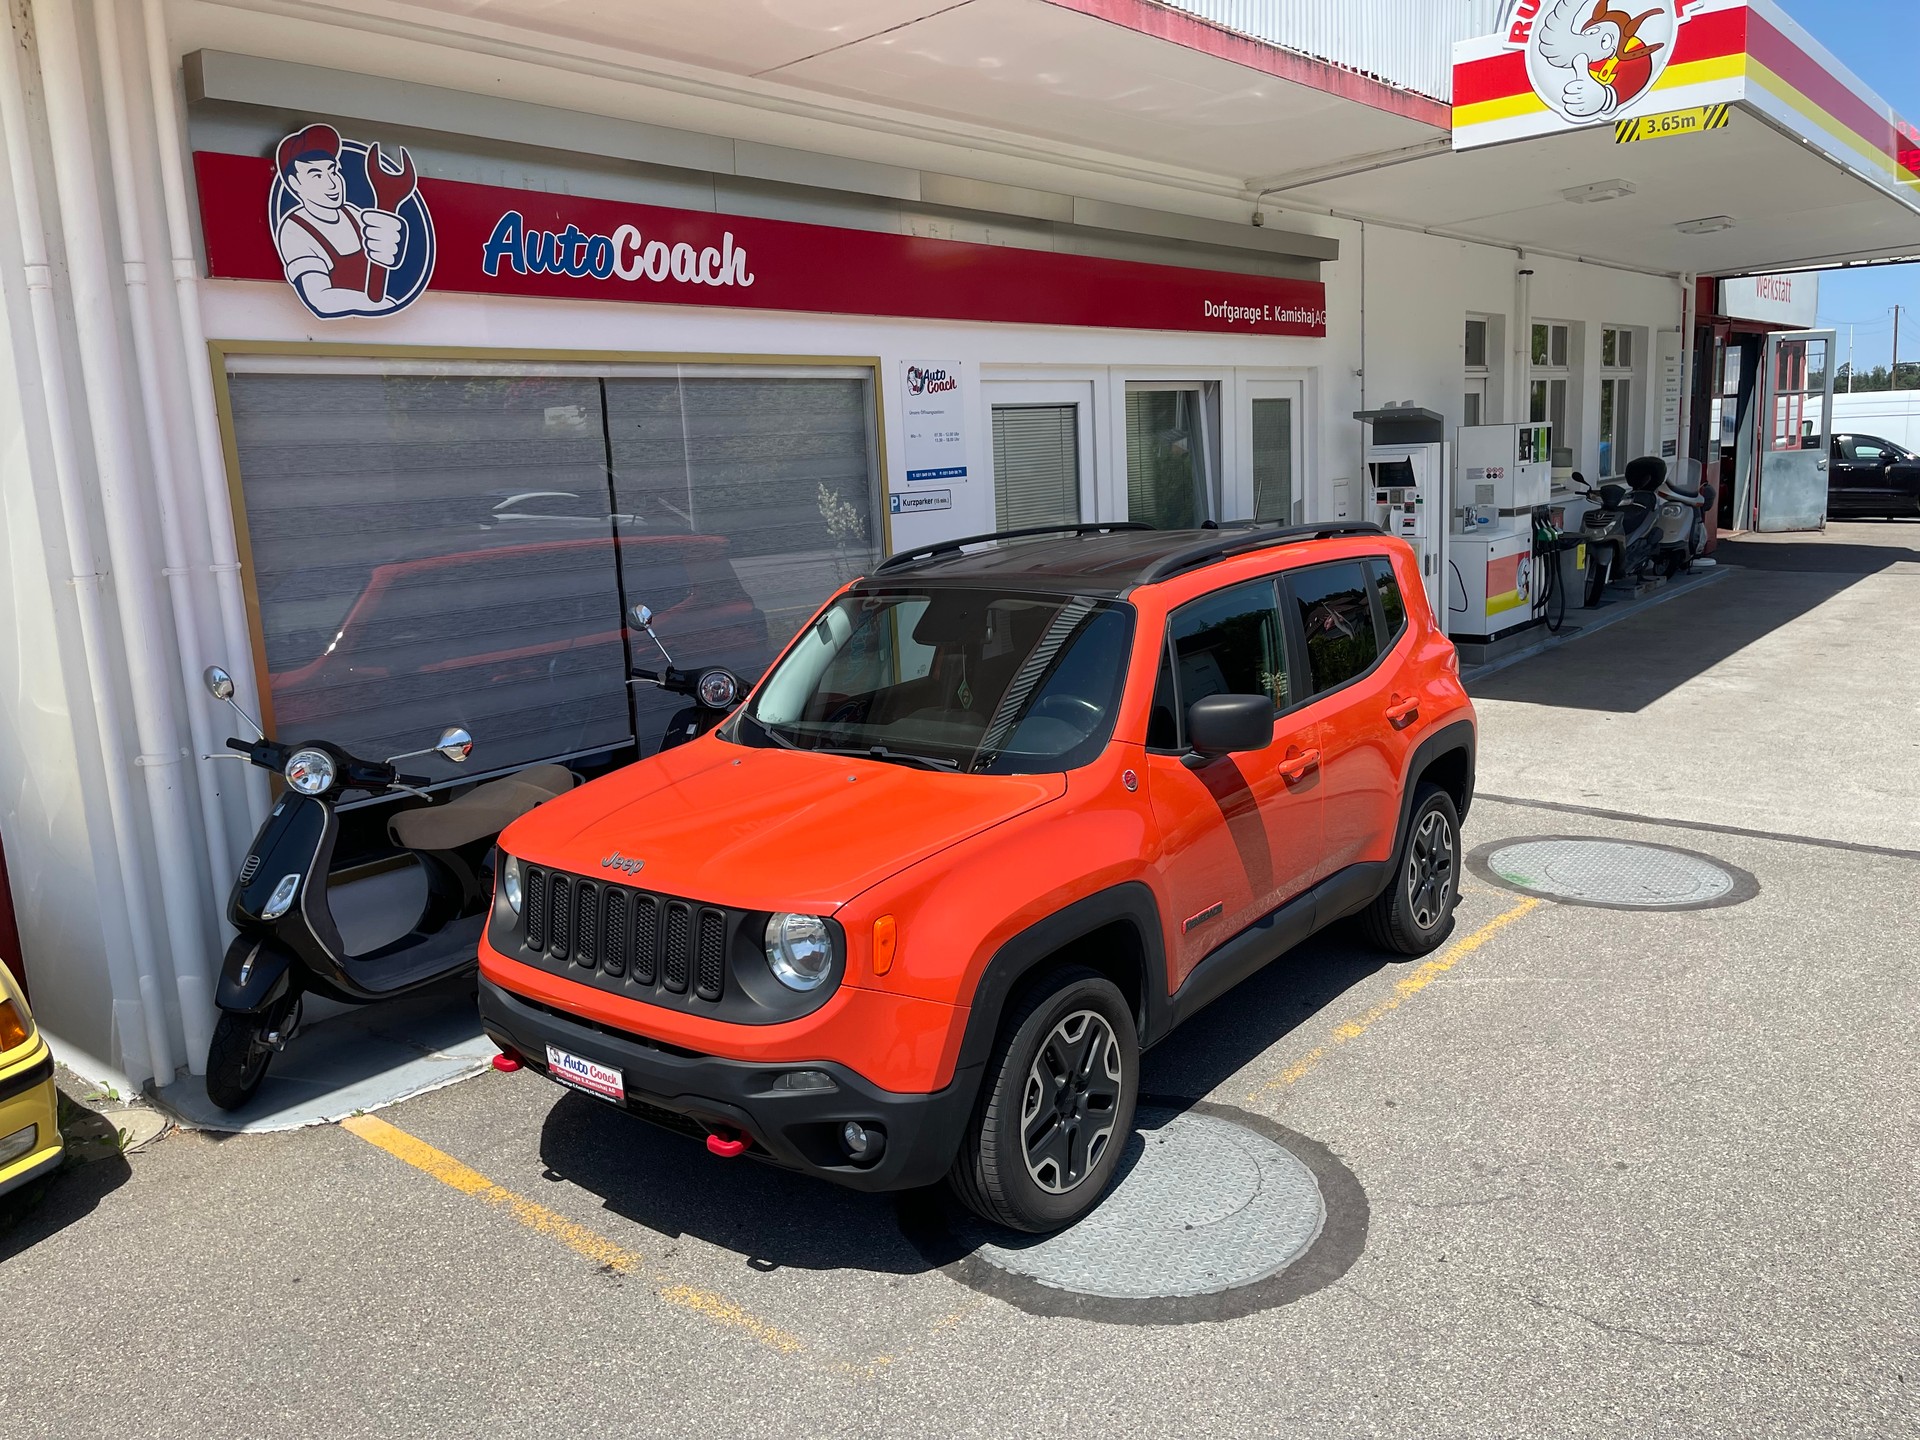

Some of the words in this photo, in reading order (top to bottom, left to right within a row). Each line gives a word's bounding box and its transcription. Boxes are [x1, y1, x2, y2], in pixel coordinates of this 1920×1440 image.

[1646, 113, 1696, 134] 3.65m
[1756, 275, 1792, 303] Werkstatt
[1204, 299, 1262, 324] Dorfgarage
[1263, 304, 1272, 321] E.
[1274, 305, 1315, 328] Kamishaj
[924, 368, 946, 385] Auto
[927, 375, 958, 394] Coach
[902, 498, 934, 507] Kurzparker
[601, 851, 646, 876] Jeep
[564, 1055, 588, 1075] Auto
[590, 1066, 618, 1085] Coach
